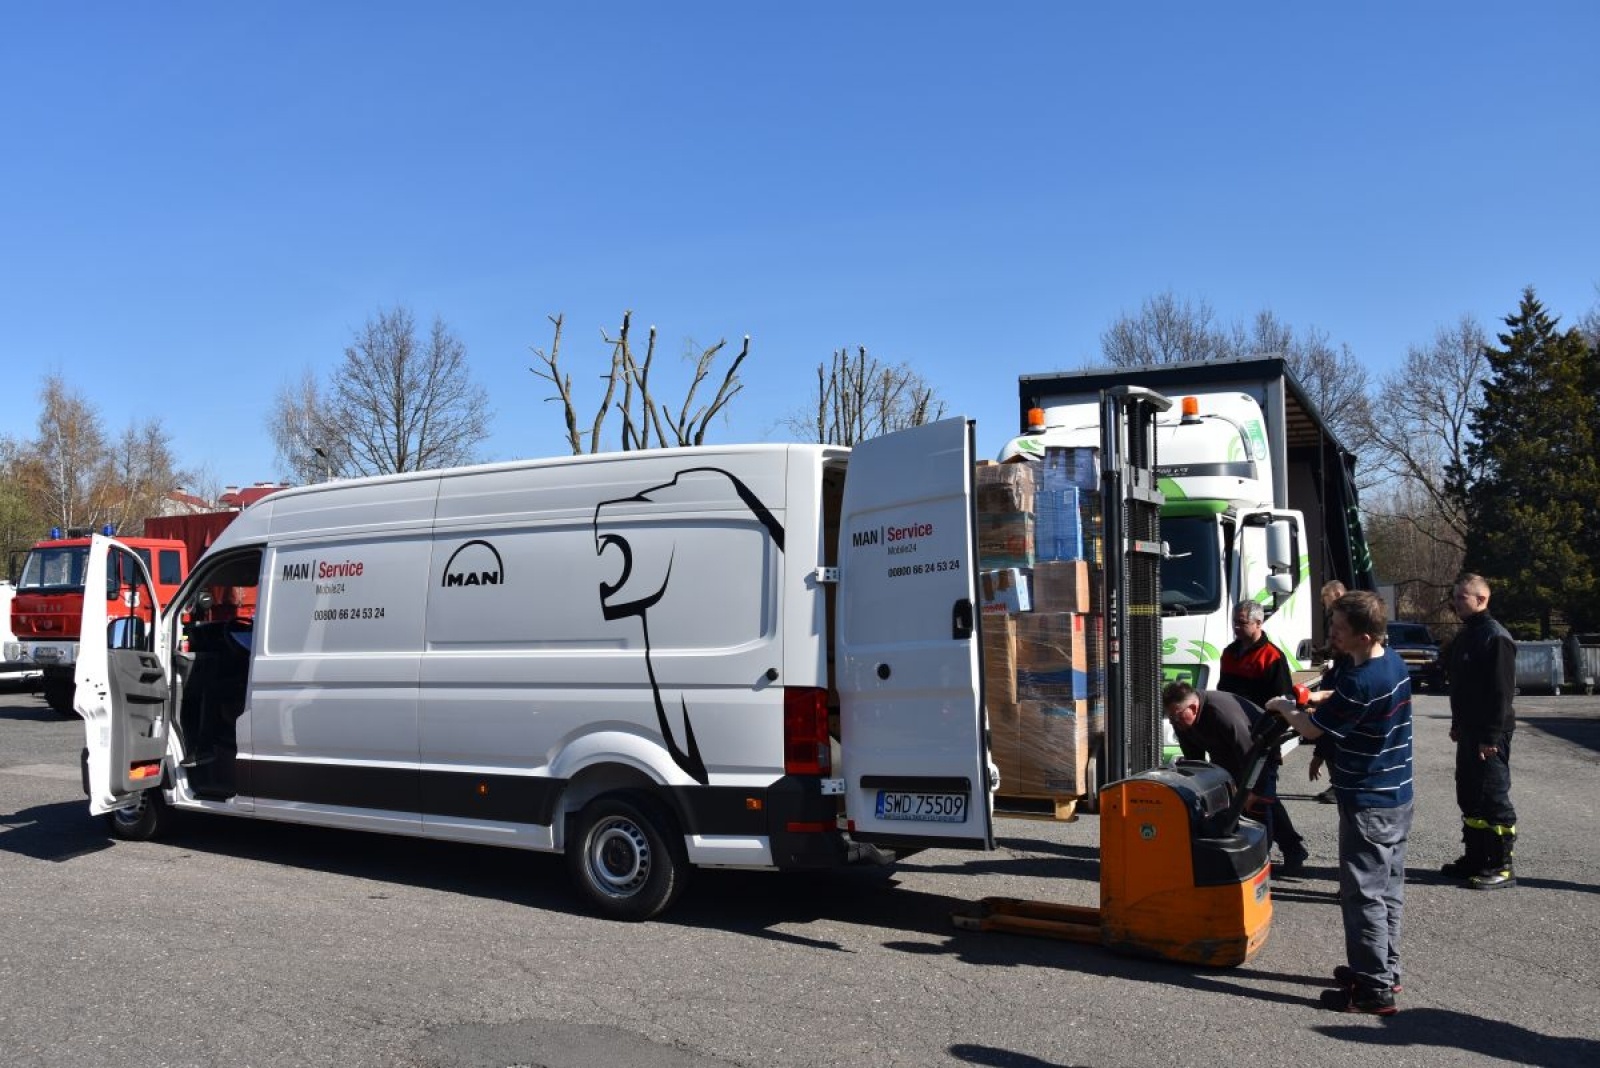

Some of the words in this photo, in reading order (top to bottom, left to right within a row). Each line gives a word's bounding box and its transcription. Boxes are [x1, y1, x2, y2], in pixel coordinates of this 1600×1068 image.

[852, 530, 878, 547] MAN
[887, 523, 933, 542] Service
[283, 564, 310, 581] MAN
[318, 560, 364, 579] Service
[887, 566, 912, 578] 00800
[912, 564, 924, 575] 66
[924, 563, 935, 573] 24
[936, 561, 948, 572] 53
[949, 559, 960, 570] 24
[447, 571, 498, 587] MAN
[314, 609, 337, 621] 00800
[338, 608, 349, 620] 66
[350, 608, 360, 619] 24
[362, 607, 373, 619] 53
[374, 607, 385, 619] 24
[885, 794, 911, 813] SWD
[915, 795, 963, 815] 75509
